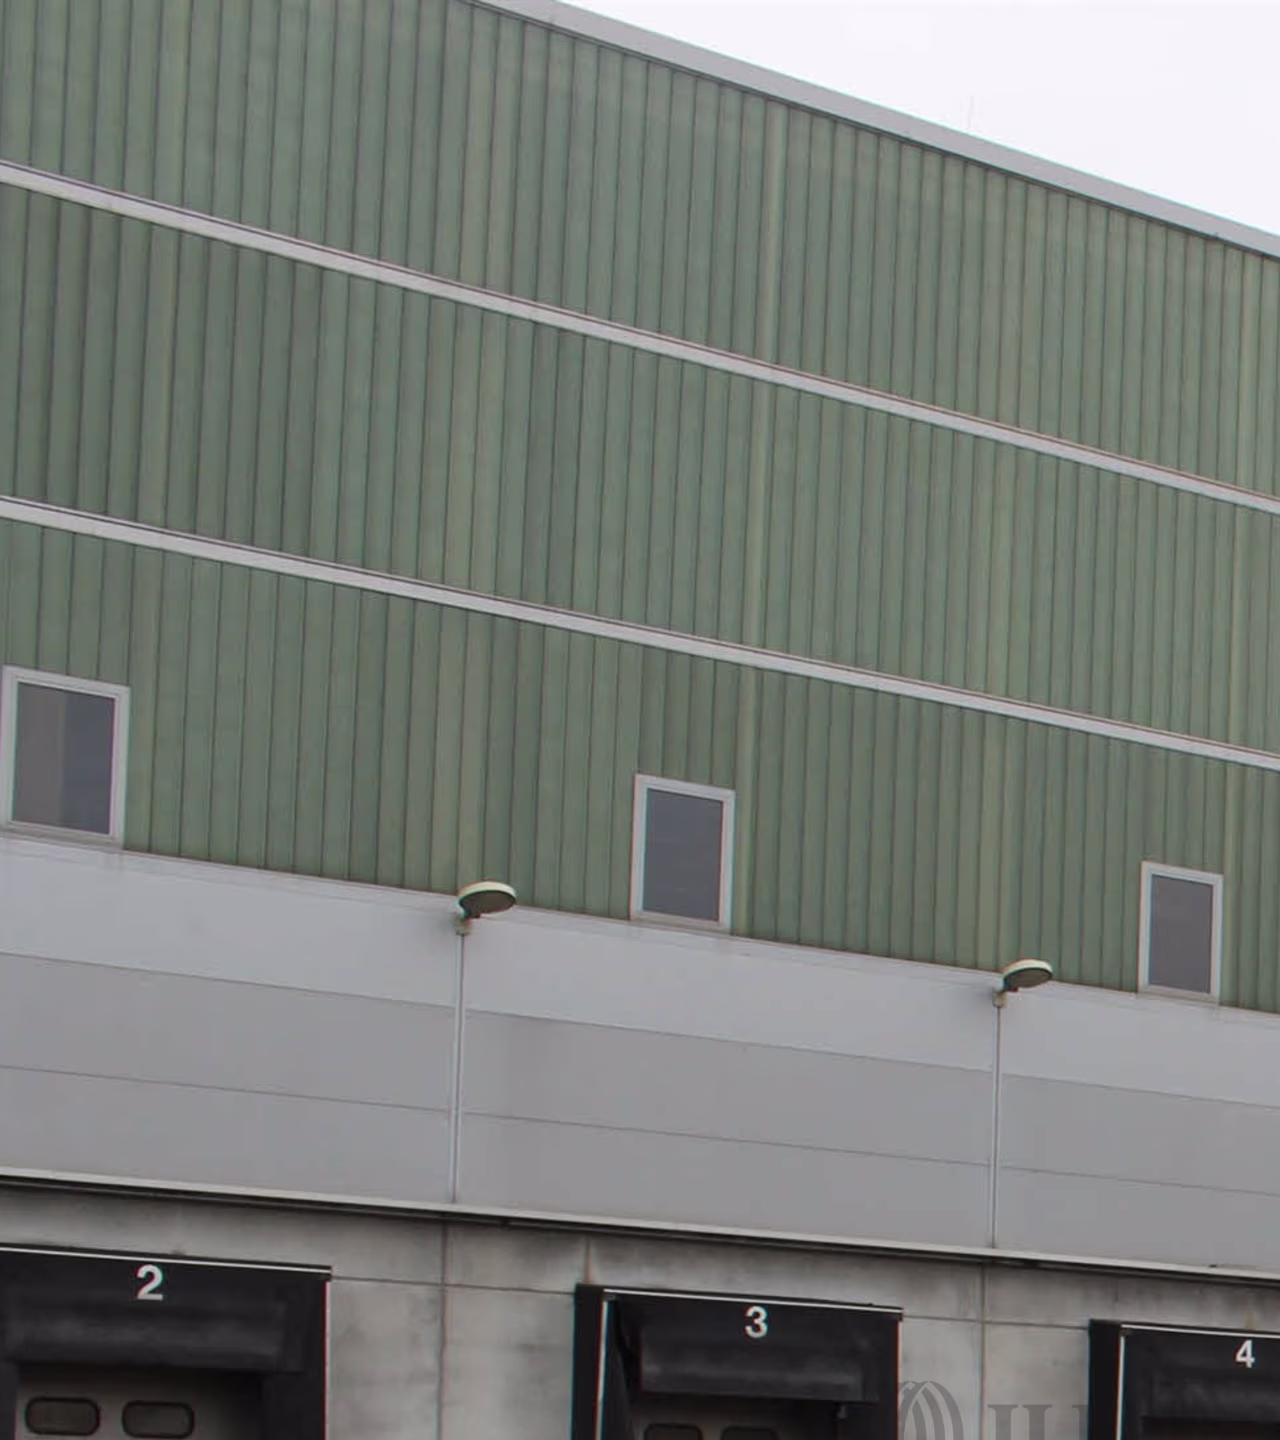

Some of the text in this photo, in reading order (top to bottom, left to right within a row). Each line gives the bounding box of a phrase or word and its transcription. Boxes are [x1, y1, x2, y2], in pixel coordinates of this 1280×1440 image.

[136, 1264, 163, 1301] 2
[745, 1305, 768, 1338] 3
[1235, 1339, 1256, 1369] 4
